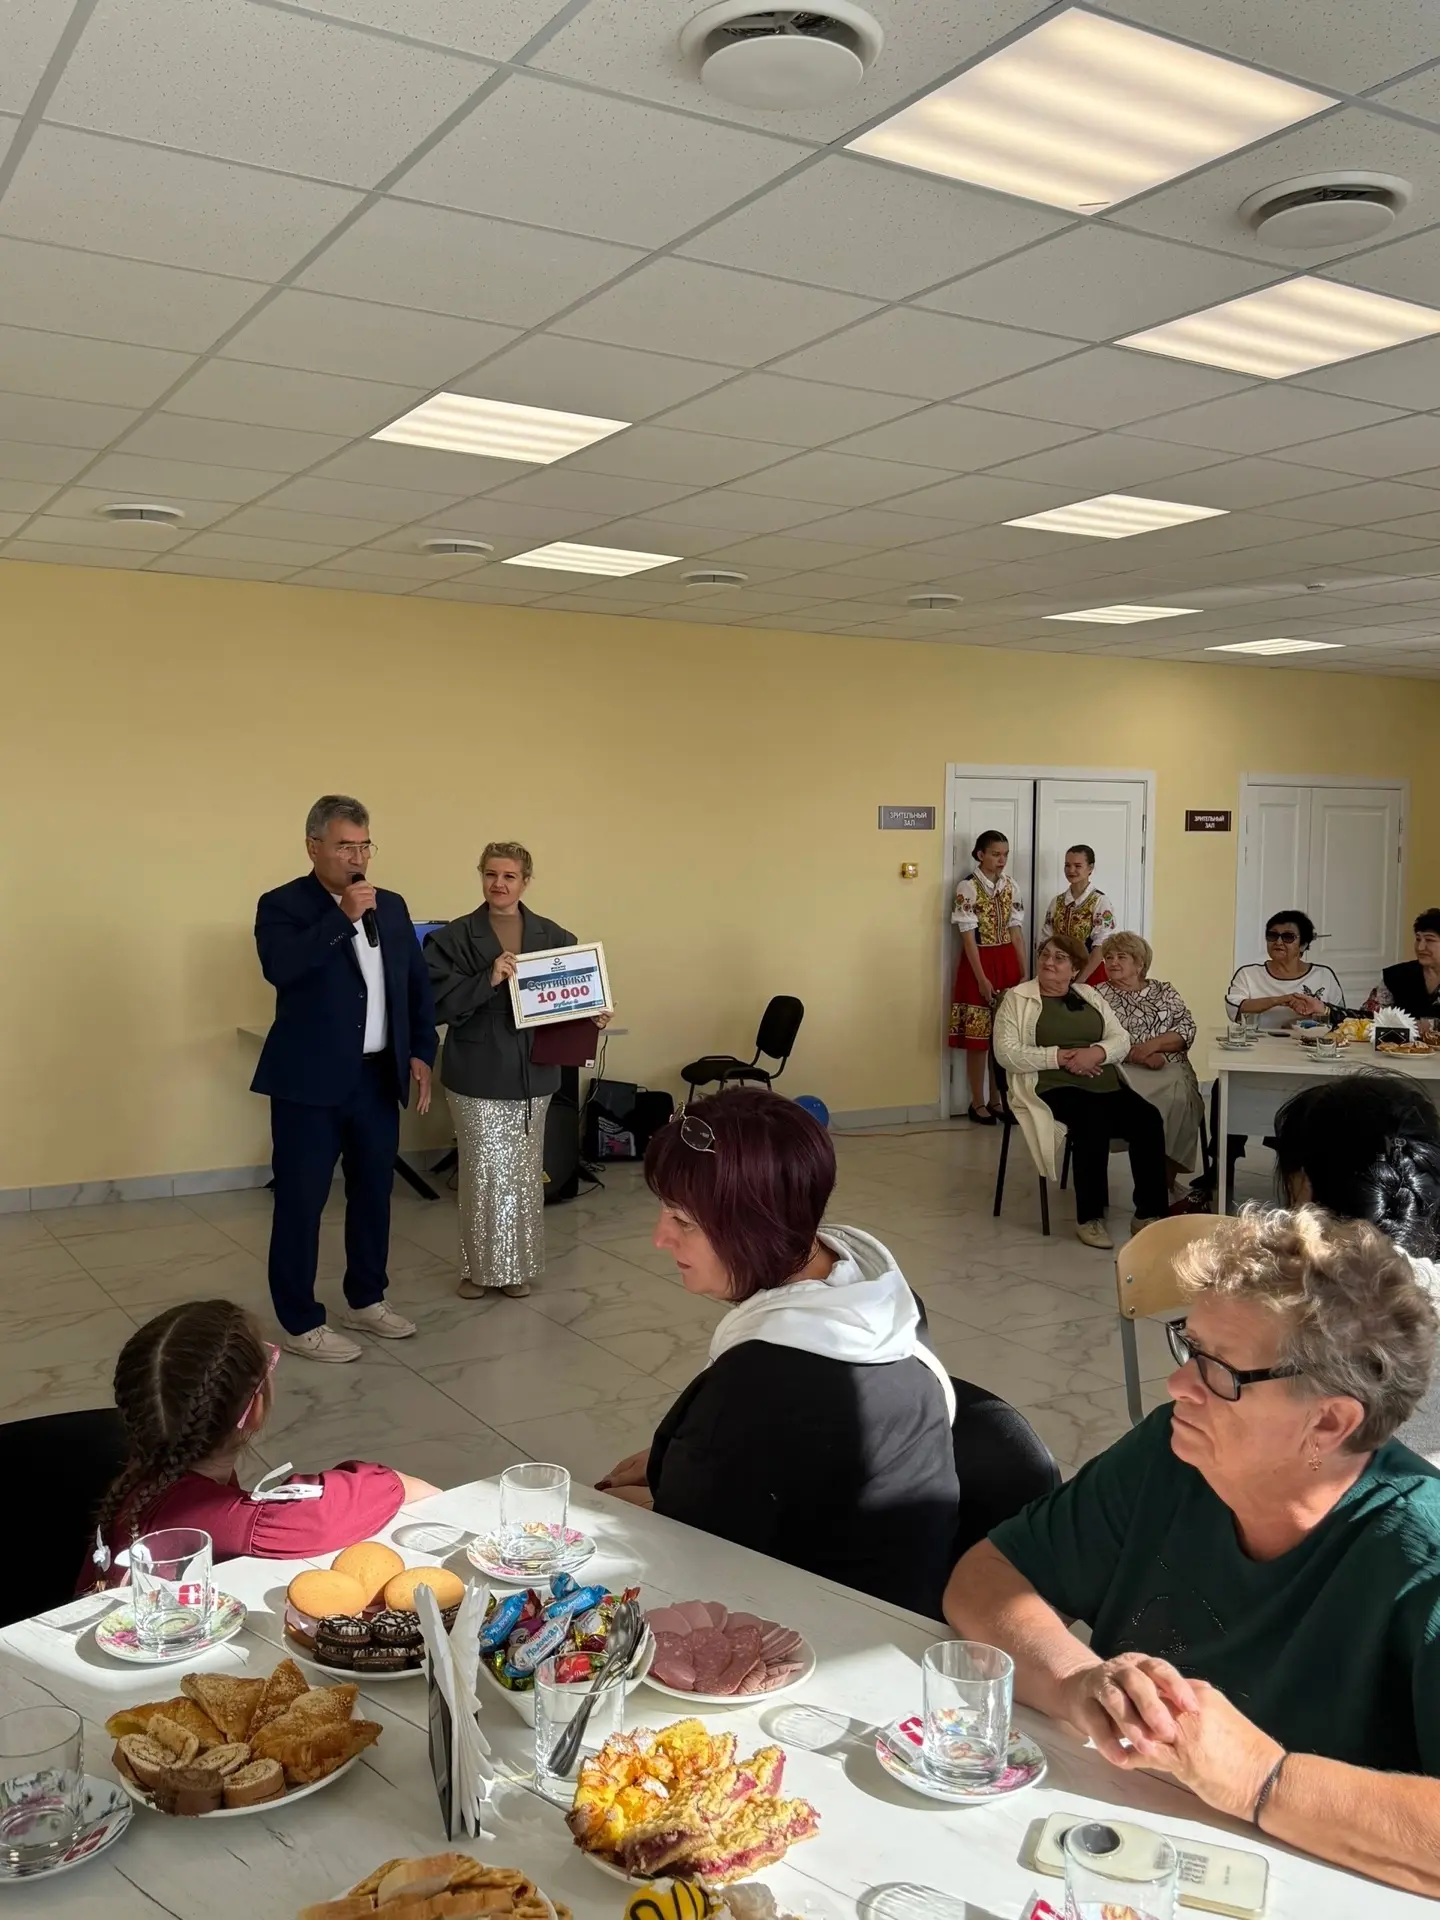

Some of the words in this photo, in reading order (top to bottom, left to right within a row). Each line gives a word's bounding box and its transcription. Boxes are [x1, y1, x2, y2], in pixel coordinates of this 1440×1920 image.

[889, 811, 928, 819] ЗРИТЕЛЬНЫЙ
[903, 819, 916, 827] ЗАЛ
[526, 973, 593, 991] Сертификат
[537, 990, 557, 1004] 10
[560, 985, 590, 999] 000
